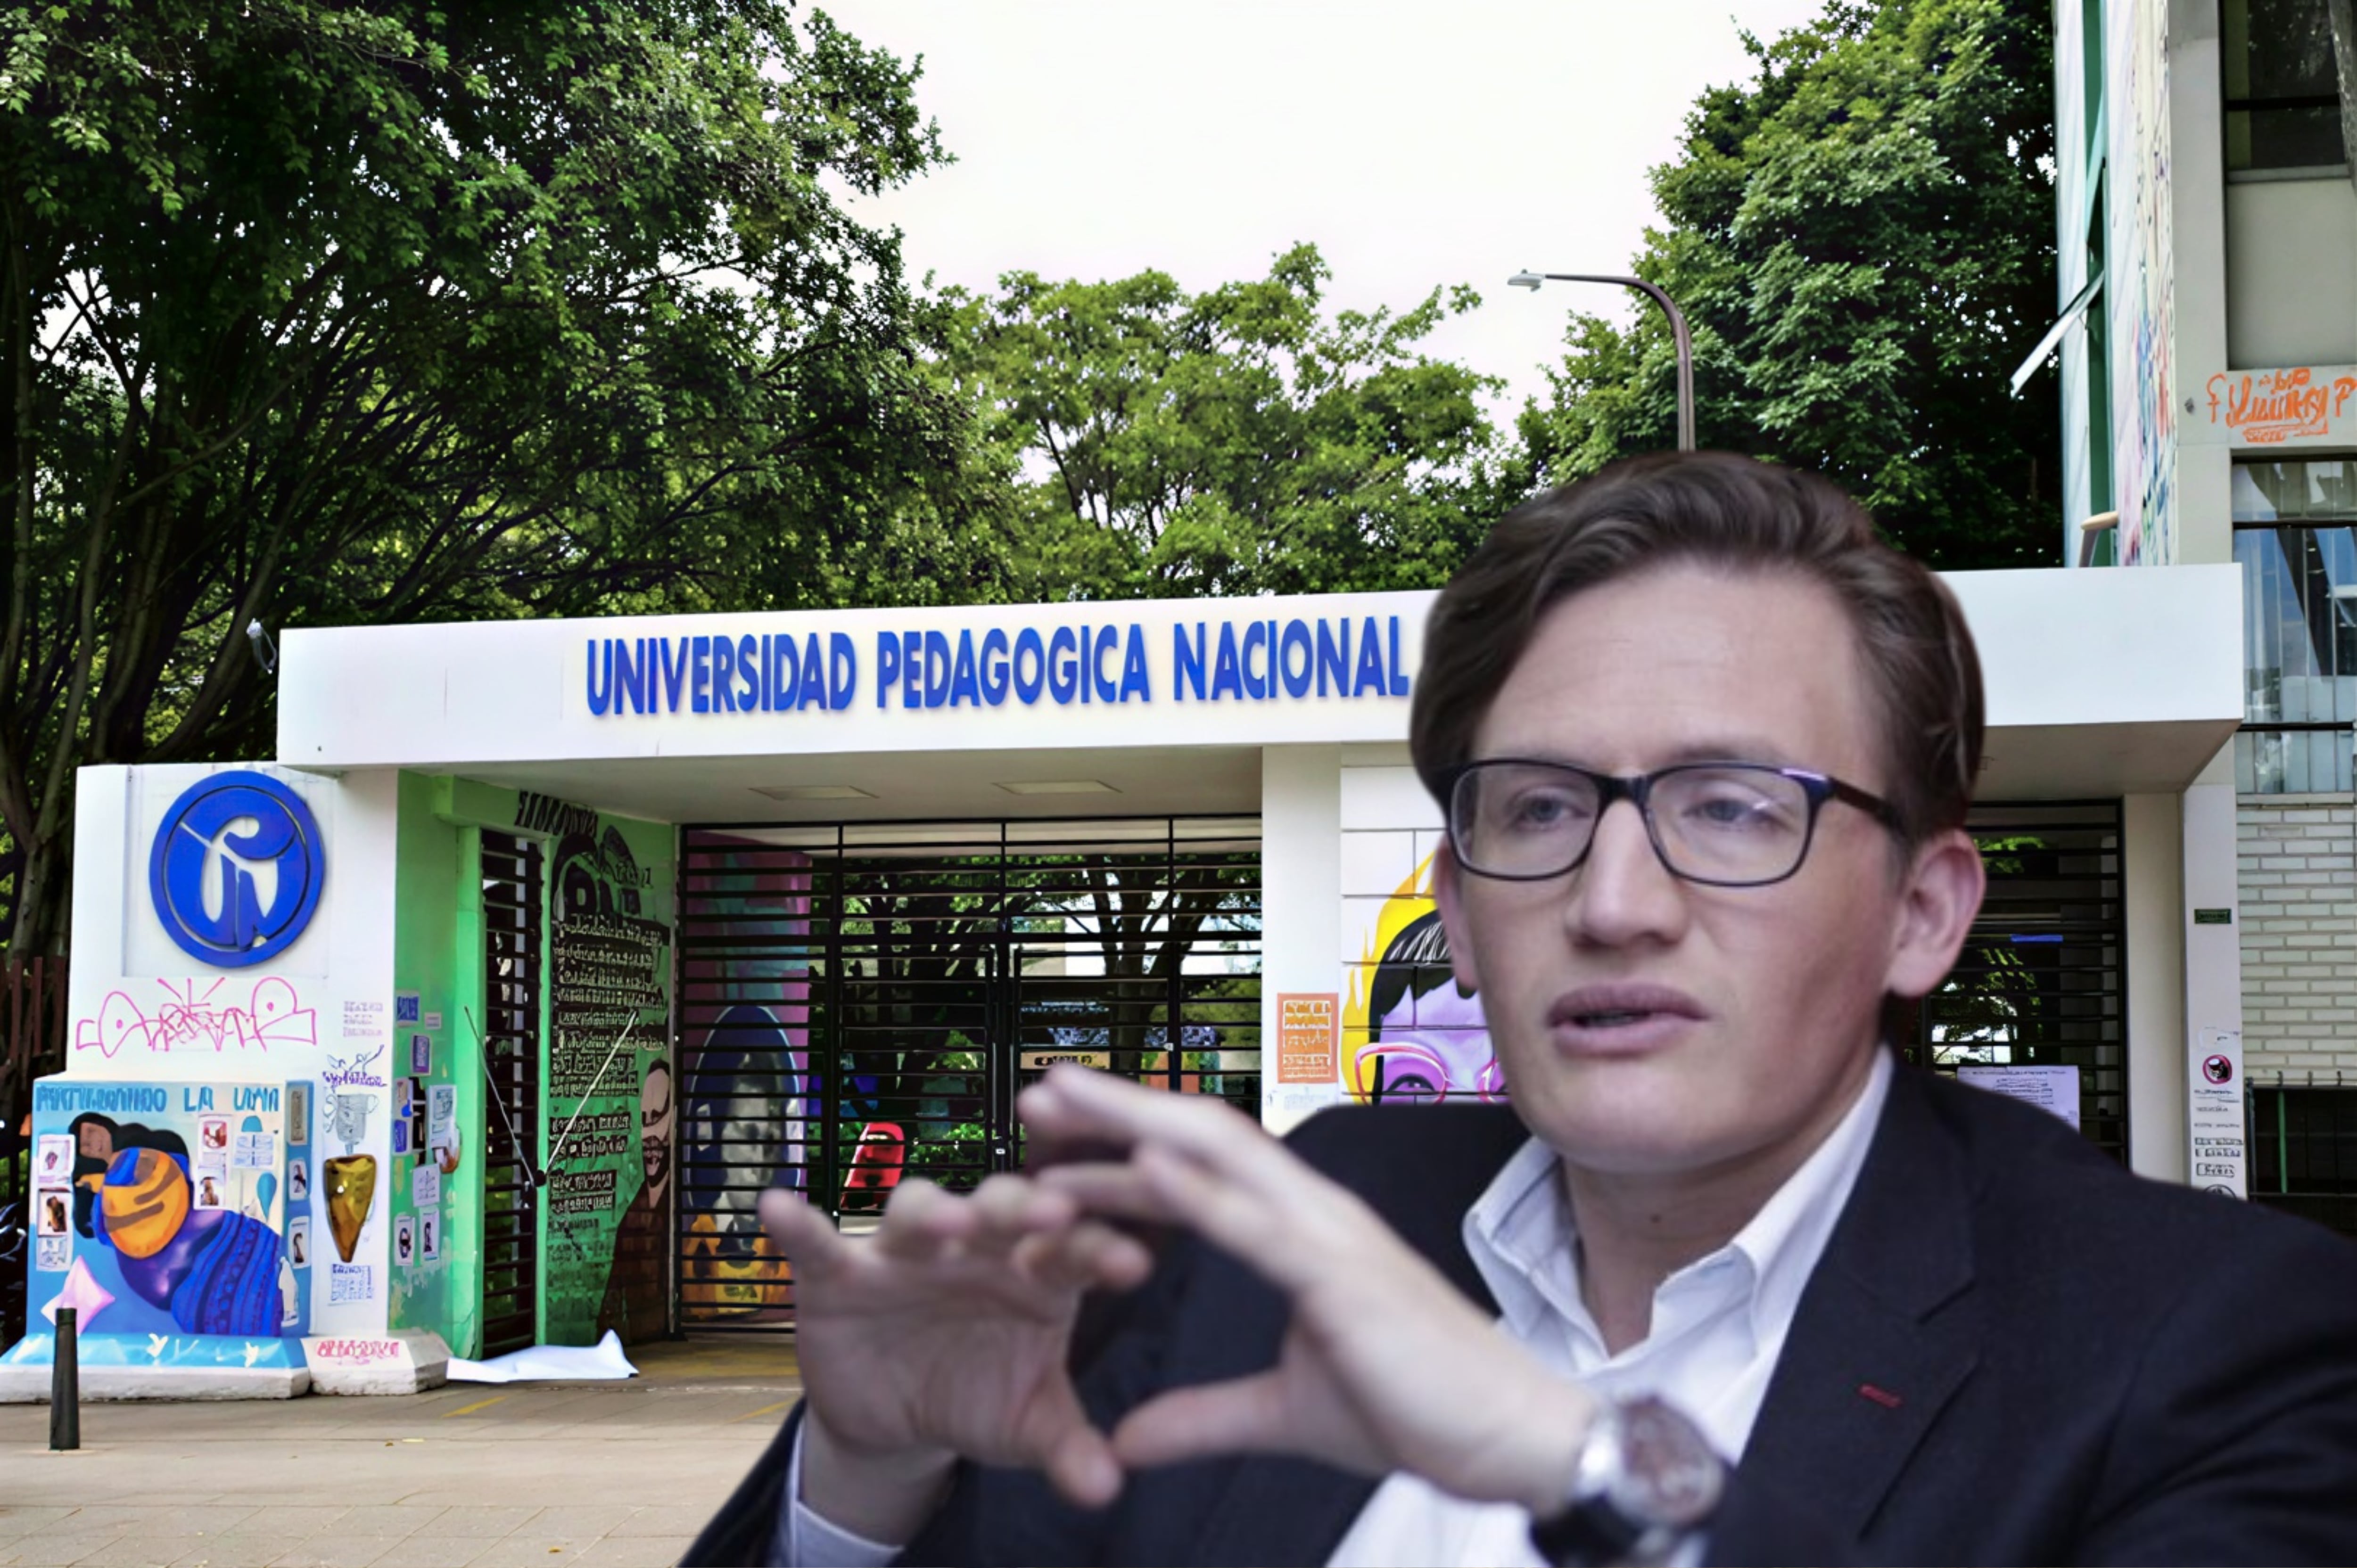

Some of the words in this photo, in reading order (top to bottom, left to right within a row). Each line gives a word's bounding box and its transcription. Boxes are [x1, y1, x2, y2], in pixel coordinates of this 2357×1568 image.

[587, 632, 857, 717] UNIVERSIDAD
[877, 624, 1151, 709] PEDAGOGICA
[1173, 616, 1409, 701] NACIONAL
